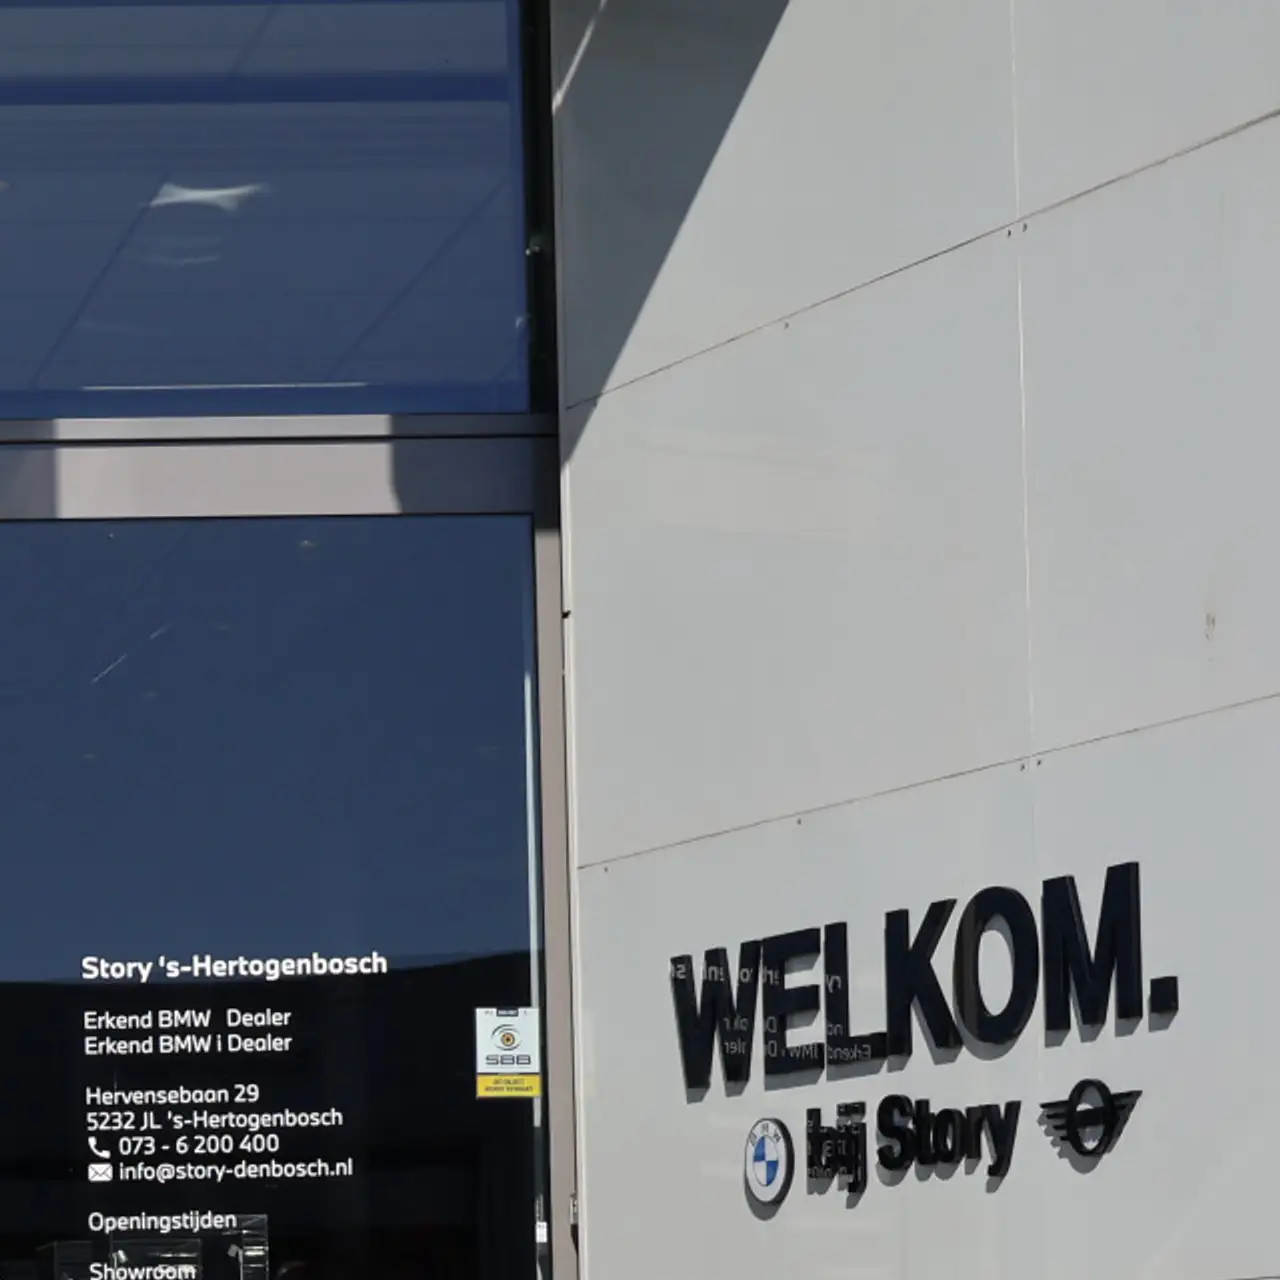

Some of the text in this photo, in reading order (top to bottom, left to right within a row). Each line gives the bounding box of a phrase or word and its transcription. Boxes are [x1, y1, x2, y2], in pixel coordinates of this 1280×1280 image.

[81, 950, 388, 983] Story 's-Hertogenbosch
[670, 860, 1179, 1092] WELKOM.
[83, 1008, 292, 1030] Erkend BMW Dealer
[84, 1033, 293, 1055] Erkend BMW i Dealer
[85, 1083, 260, 1107] Hervensebaan 29
[86, 1107, 343, 1132] 5232 JL 's-Hertogenbosch
[118, 1135, 156, 1156] 073
[175, 1135, 189, 1154] 6
[193, 1134, 234, 1154] 200
[239, 1133, 280, 1153] 400
[805, 1094, 1022, 1193] bij Story
[119, 1157, 353, 1184] info@story-denbosch.nl
[88, 1210, 237, 1234] Openingstijden
